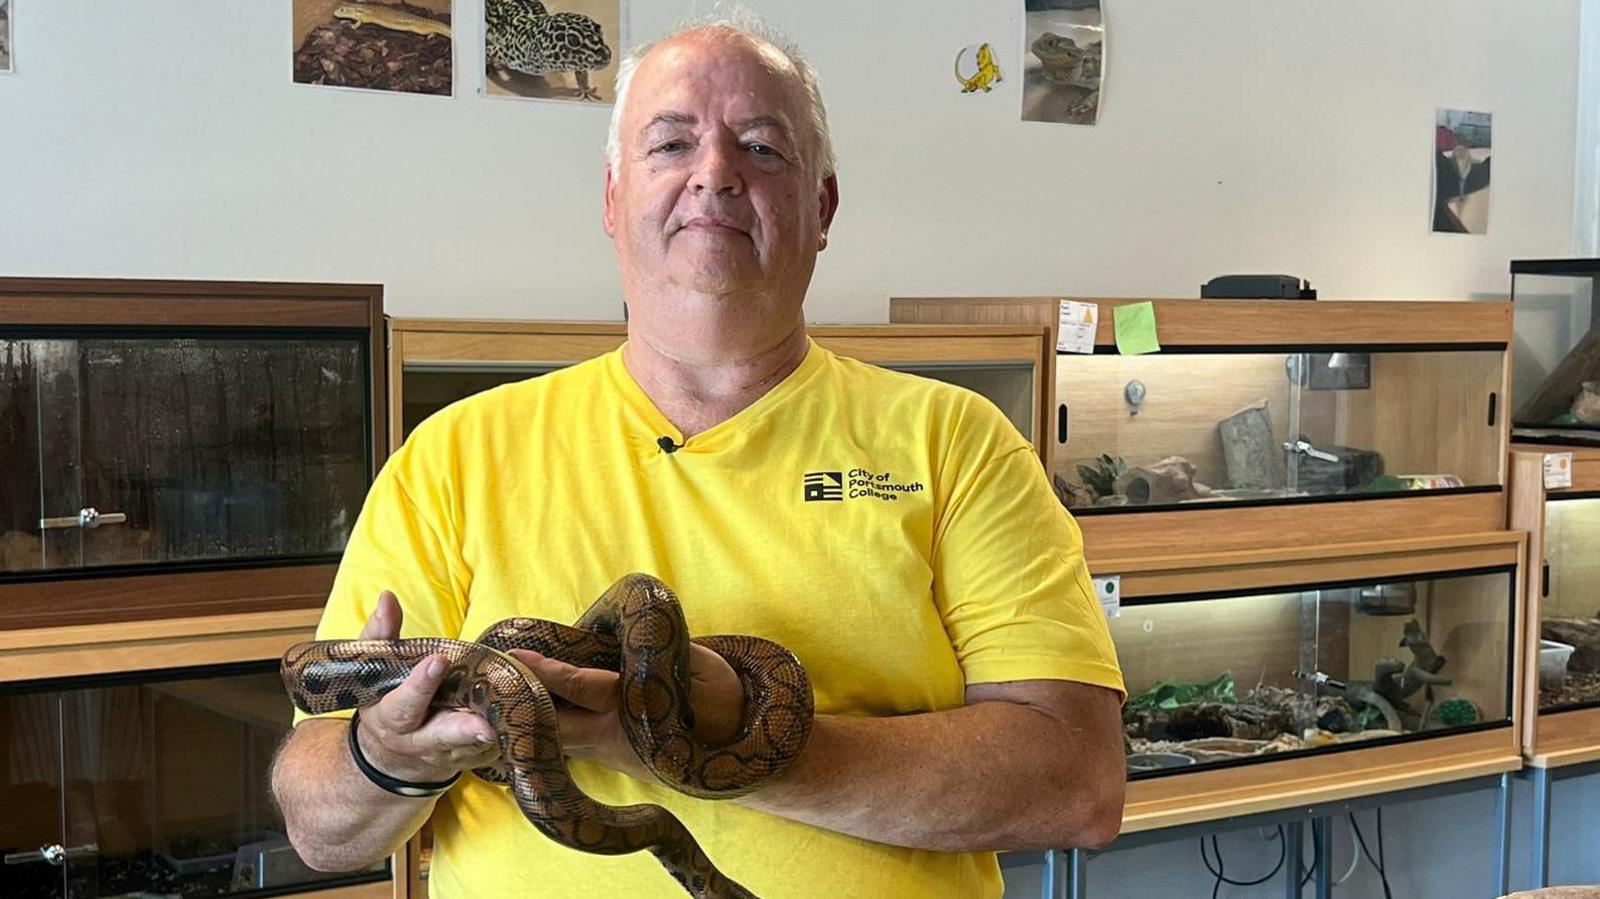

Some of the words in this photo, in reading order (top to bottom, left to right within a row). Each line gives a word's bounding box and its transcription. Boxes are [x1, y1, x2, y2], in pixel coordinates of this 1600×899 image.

[848, 468, 873, 480] City
[876, 472, 890, 481] of
[849, 479, 923, 492] Portsmouth
[849, 488, 897, 500] College
